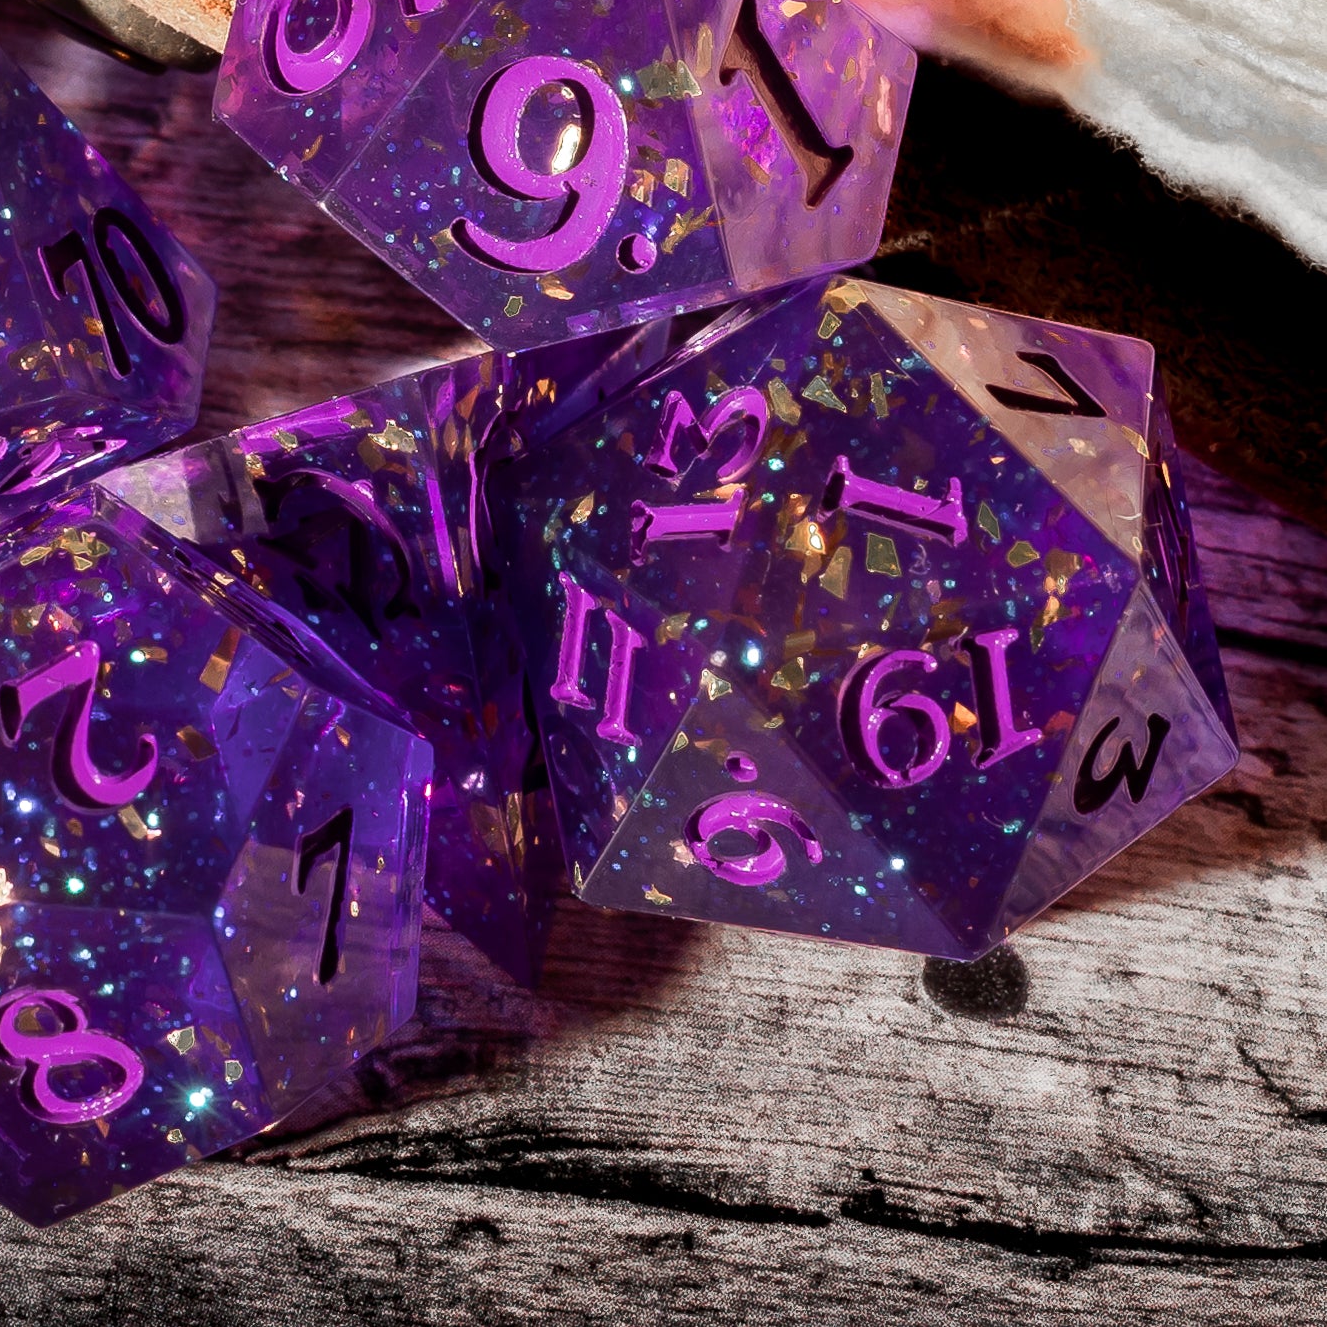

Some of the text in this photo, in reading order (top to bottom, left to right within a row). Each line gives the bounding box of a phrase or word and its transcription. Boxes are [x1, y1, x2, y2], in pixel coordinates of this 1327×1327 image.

[38, 206, 189, 380] 70
[818, 454, 968, 548] 1
[550, 571, 648, 747] 11
[1074, 713, 1171, 815] 3
